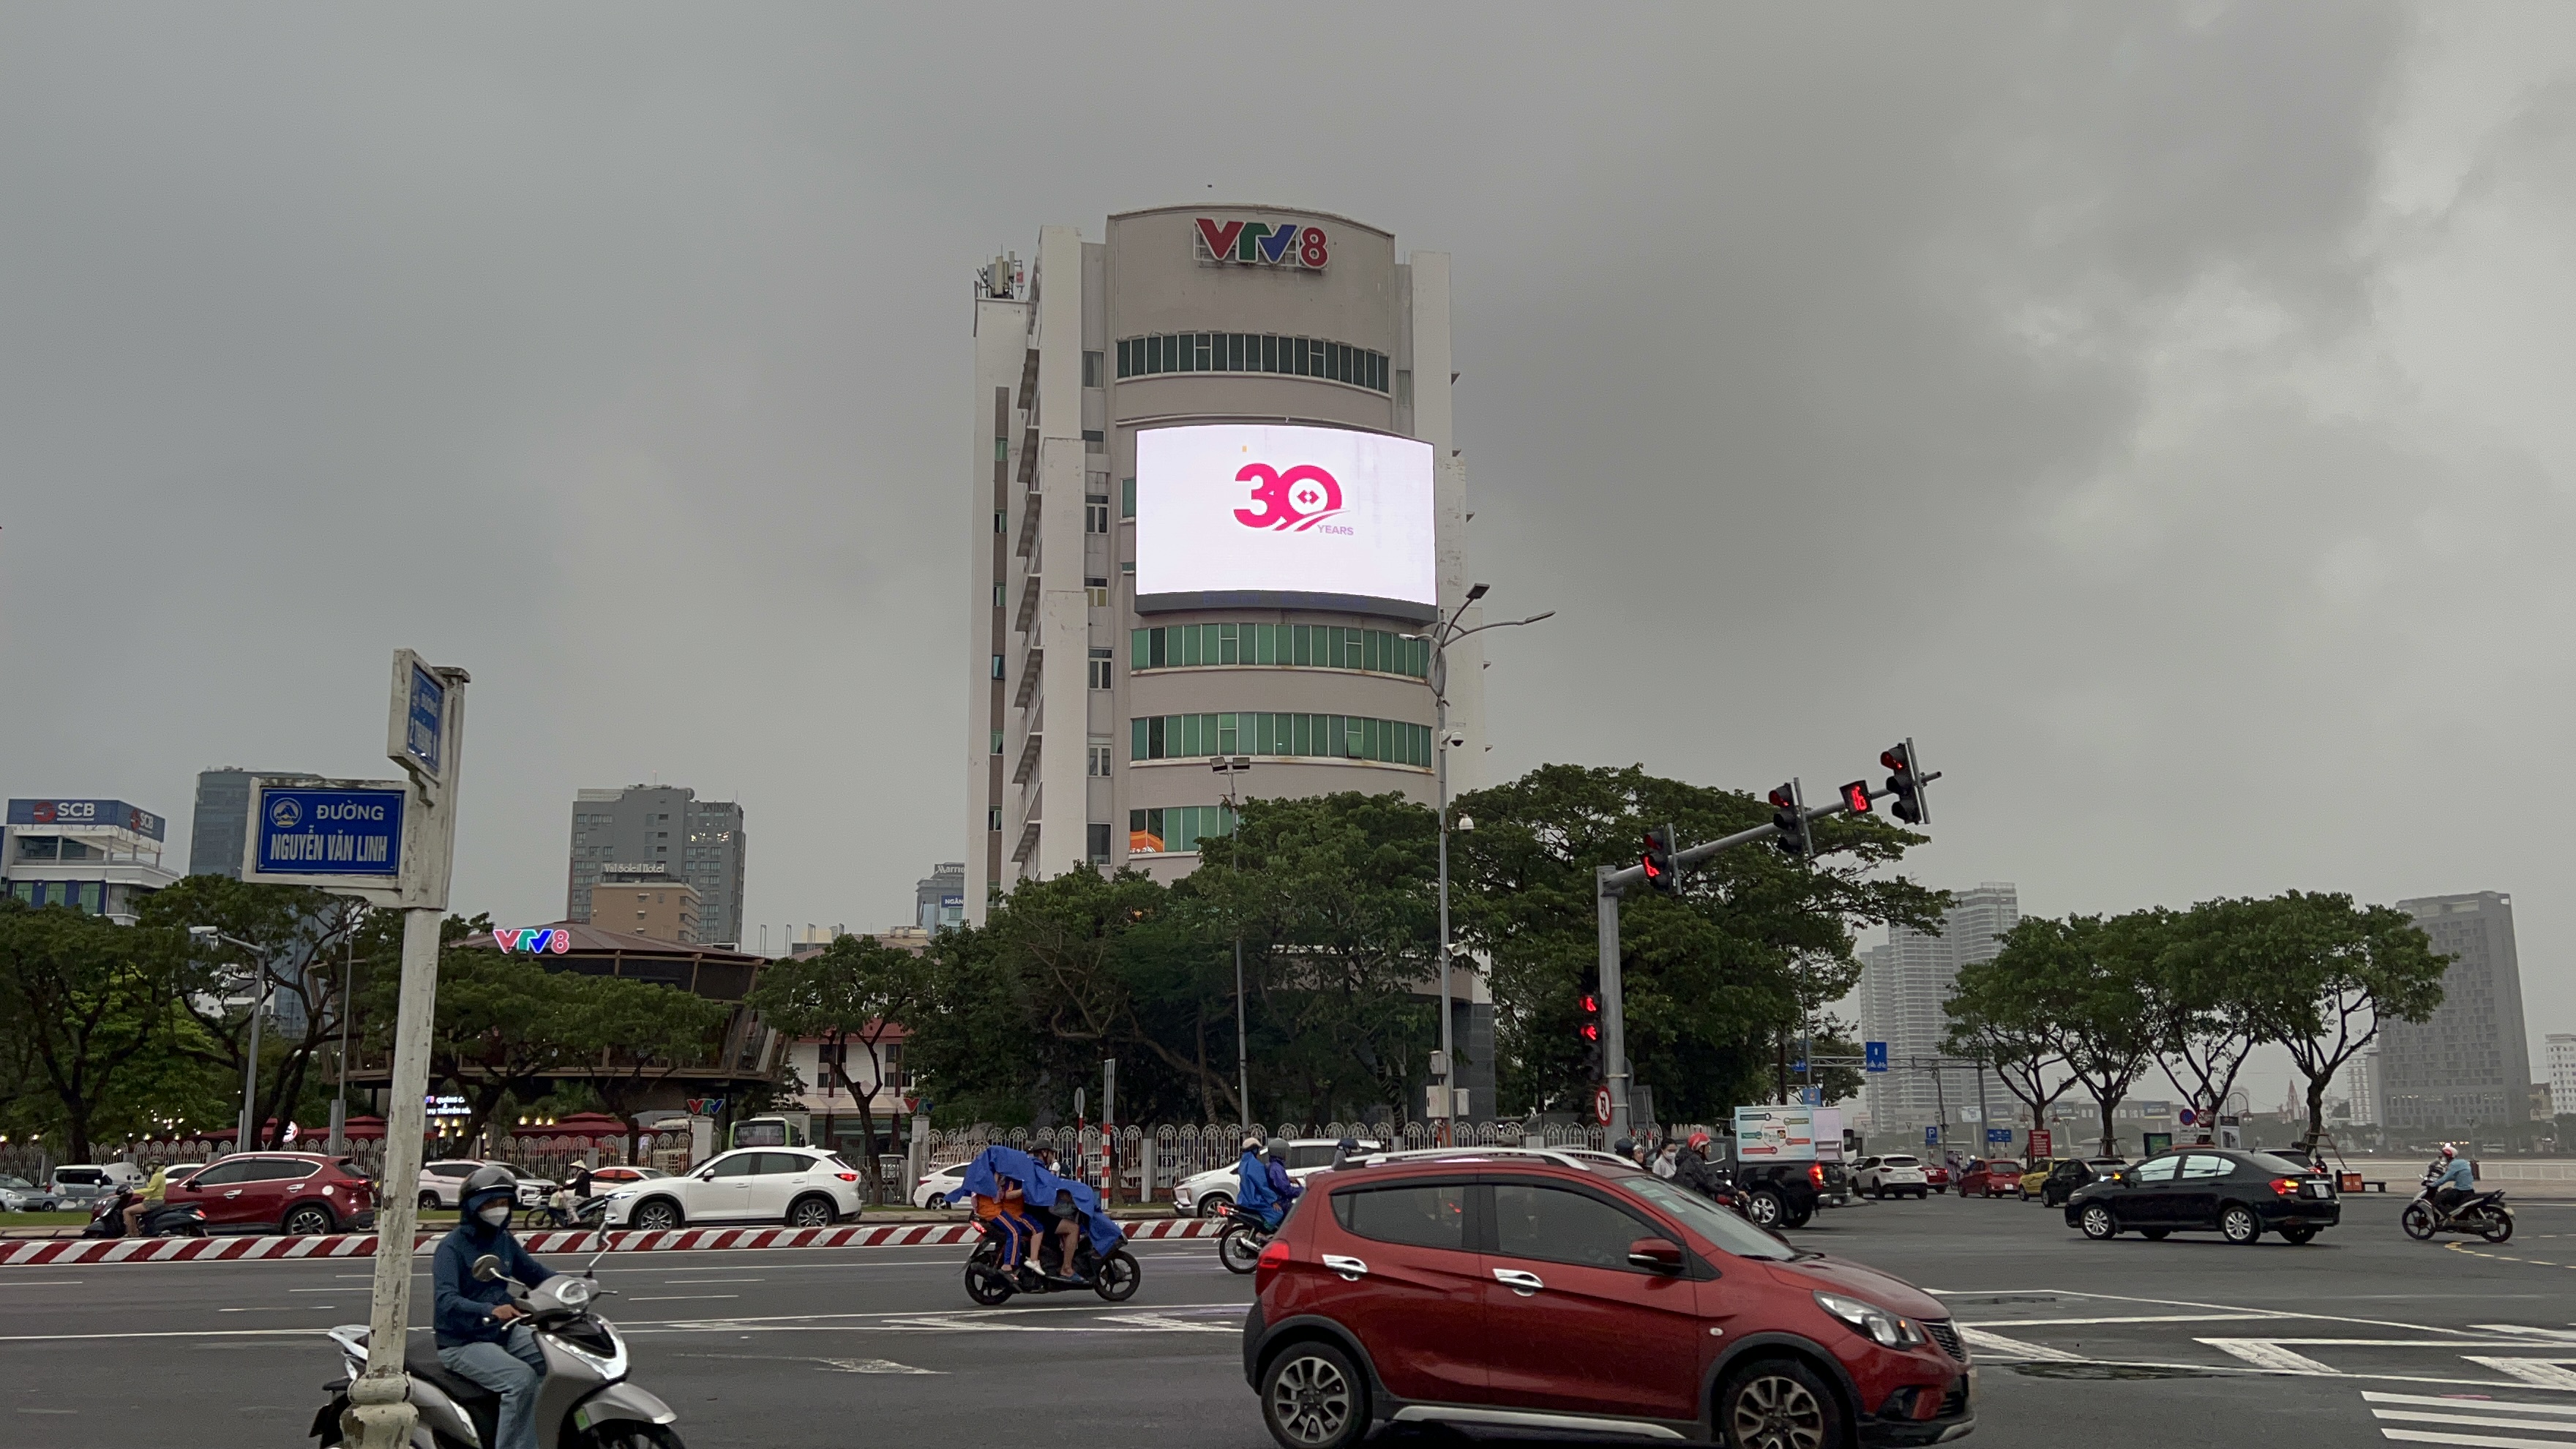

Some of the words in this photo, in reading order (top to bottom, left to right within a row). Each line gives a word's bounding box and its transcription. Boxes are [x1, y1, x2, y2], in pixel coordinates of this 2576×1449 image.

[1195, 217, 1329, 269] VTV8
[1233, 463, 1344, 532] 30
[1317, 524, 1354, 536] YEARS
[57, 802, 95, 817] SCB
[316, 799, 385, 821] ĐƯỜNG
[140, 812, 154, 829] SCB
[269, 824, 324, 861] NGUYỄN
[327, 828, 354, 861] VĂN
[356, 835, 388, 862] LINH
[643, 863, 664, 873] Hotel
[493, 929, 570, 954] VTV8
[687, 1098, 725, 1115] VTV
[1928, 1128, 1936, 1138] P
